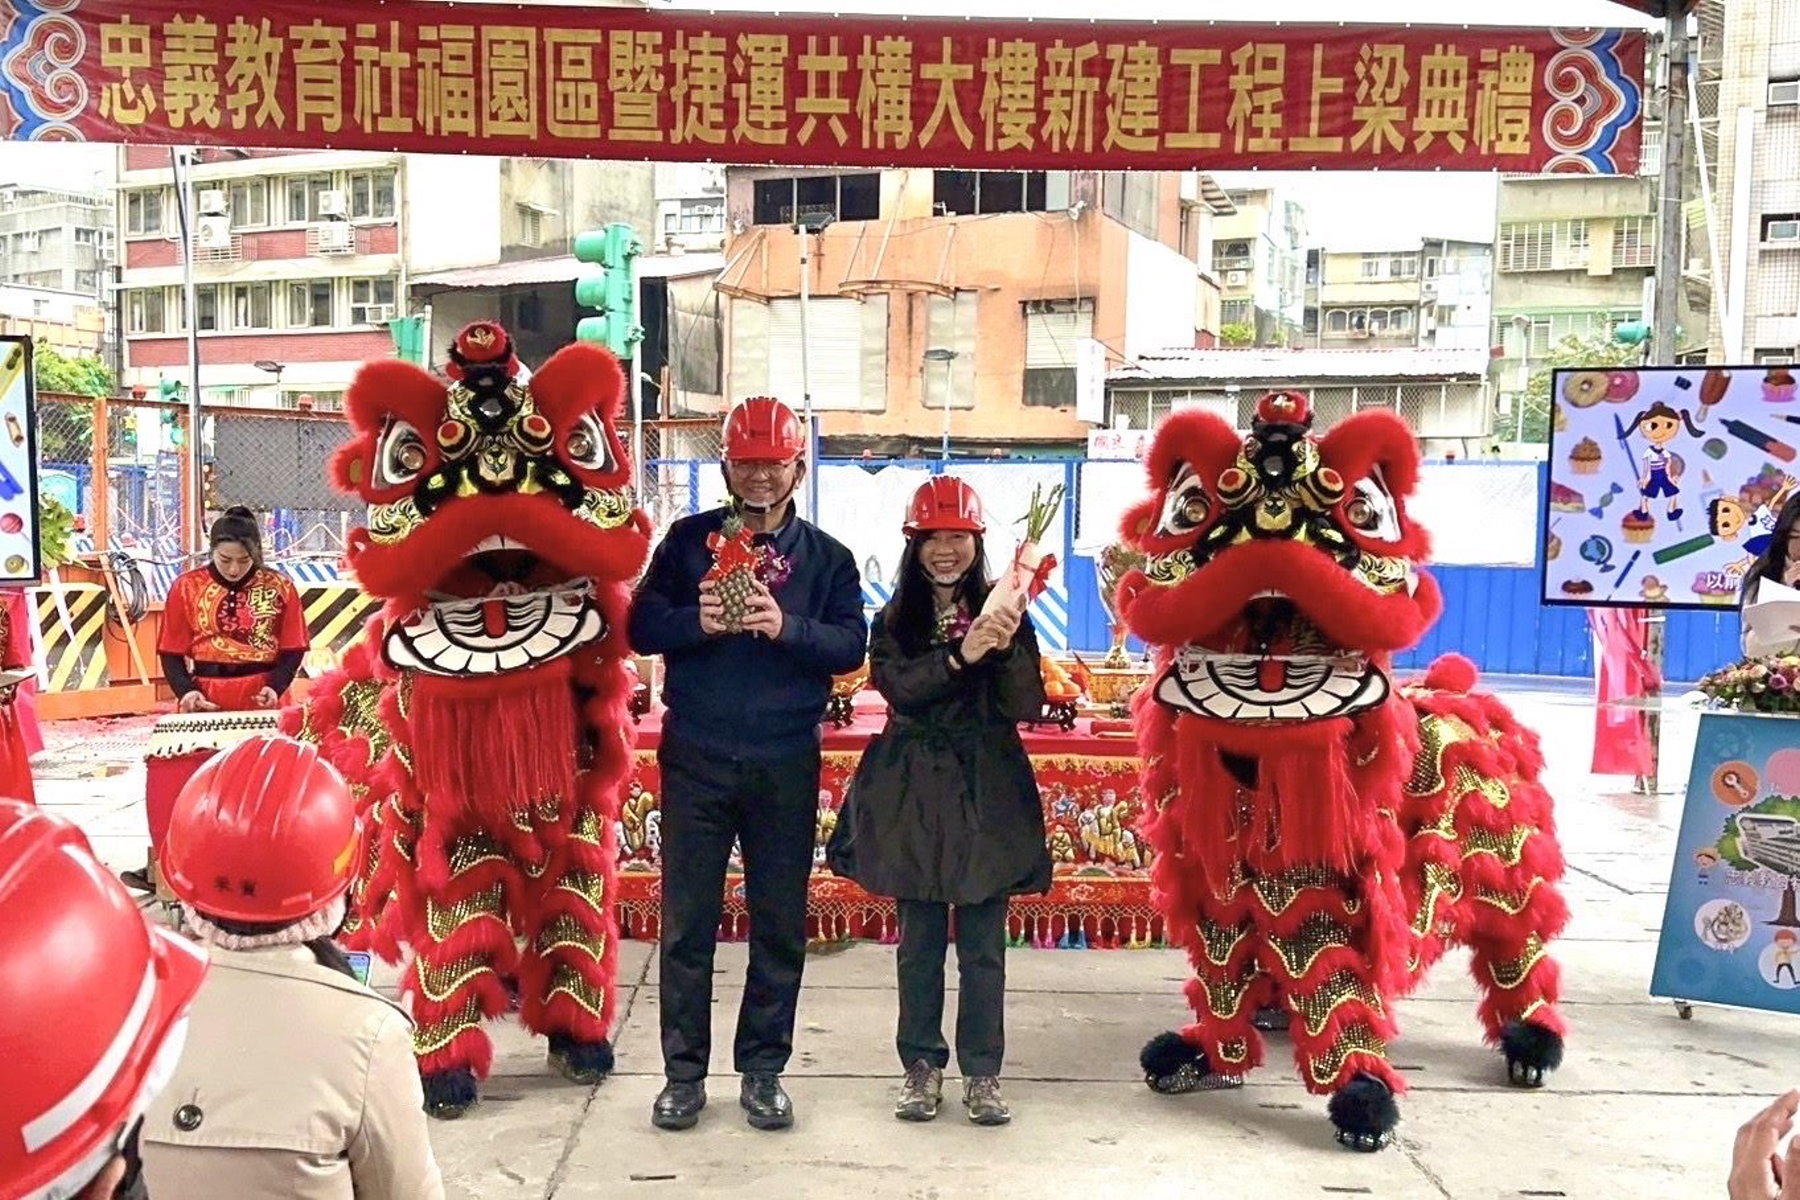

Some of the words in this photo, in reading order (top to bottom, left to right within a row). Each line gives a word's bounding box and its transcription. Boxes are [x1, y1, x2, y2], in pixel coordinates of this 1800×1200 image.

[98, 13, 1535, 155] 忠義教育社福園區暨捷運共構大樓新建工程上梁典禮
